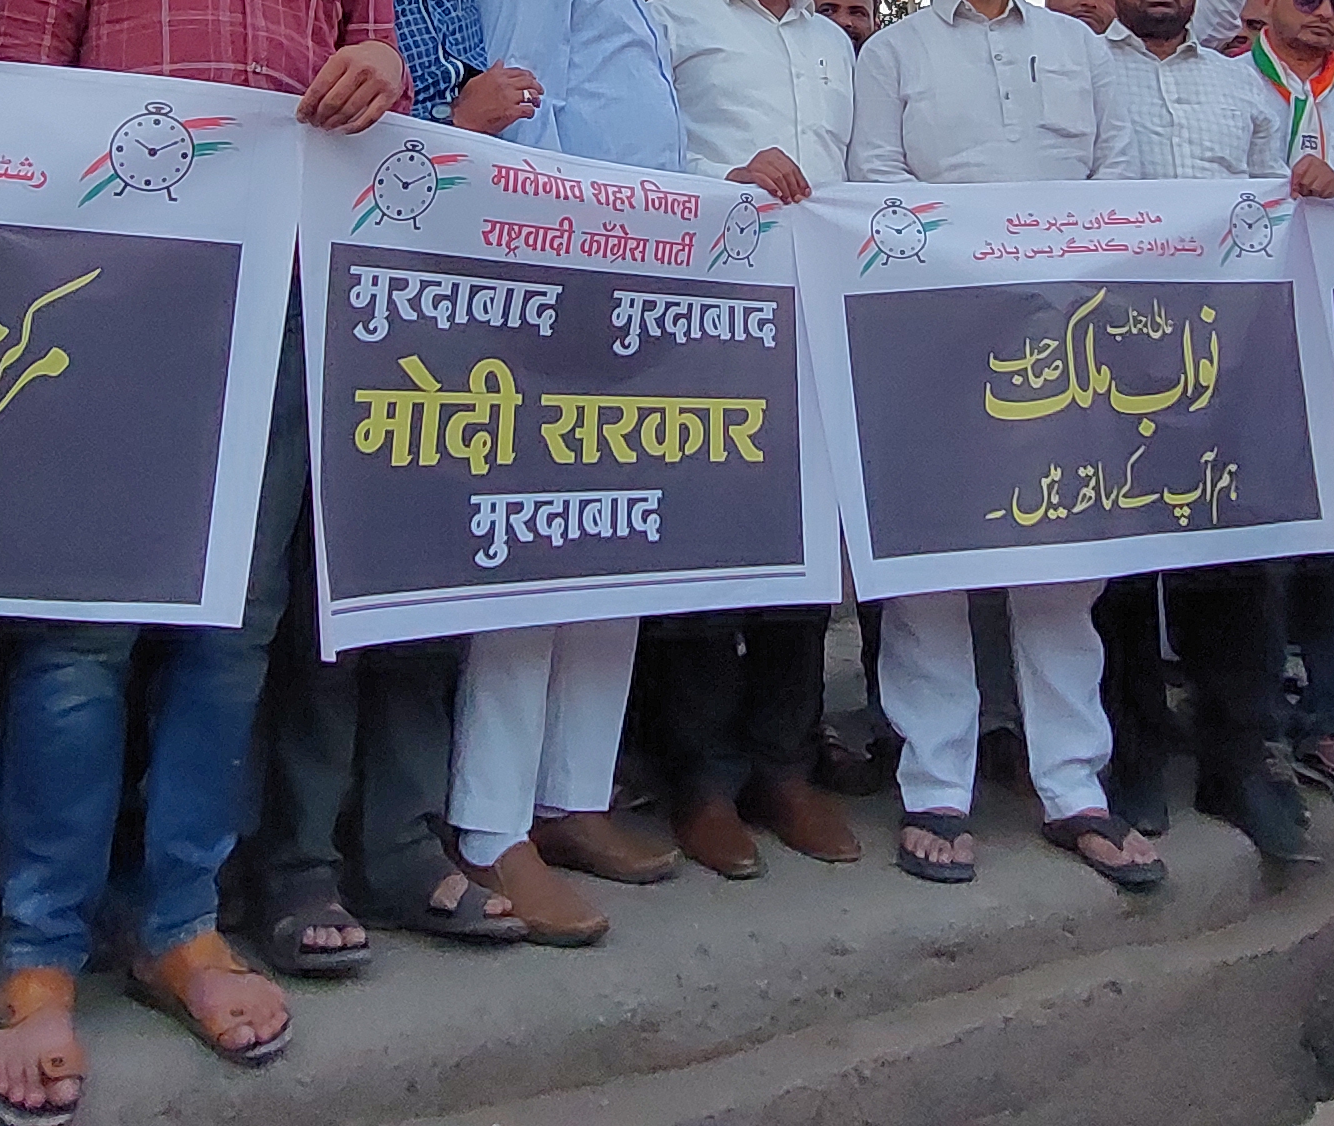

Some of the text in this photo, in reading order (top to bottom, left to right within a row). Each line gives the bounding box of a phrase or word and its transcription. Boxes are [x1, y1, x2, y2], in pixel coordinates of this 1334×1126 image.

[482, 216, 575, 258] राष्ट्रवादी
[654, 232, 697, 267] पार्टी
[590, 180, 636, 212] शहर
[640, 180, 700, 221] जिल्हा
[1005, 212, 1041, 234] ضلع
[349, 265, 778, 357] मुरदाबाद मुरदाबाद
[985, 286, 1110, 421] ملک
[1110, 304, 1218, 437] نواب
[353, 355, 767, 476] मोदी सरकार
[1163, 445, 1217, 527] آپ
[469, 488, 664, 568] मुरदाबाद
